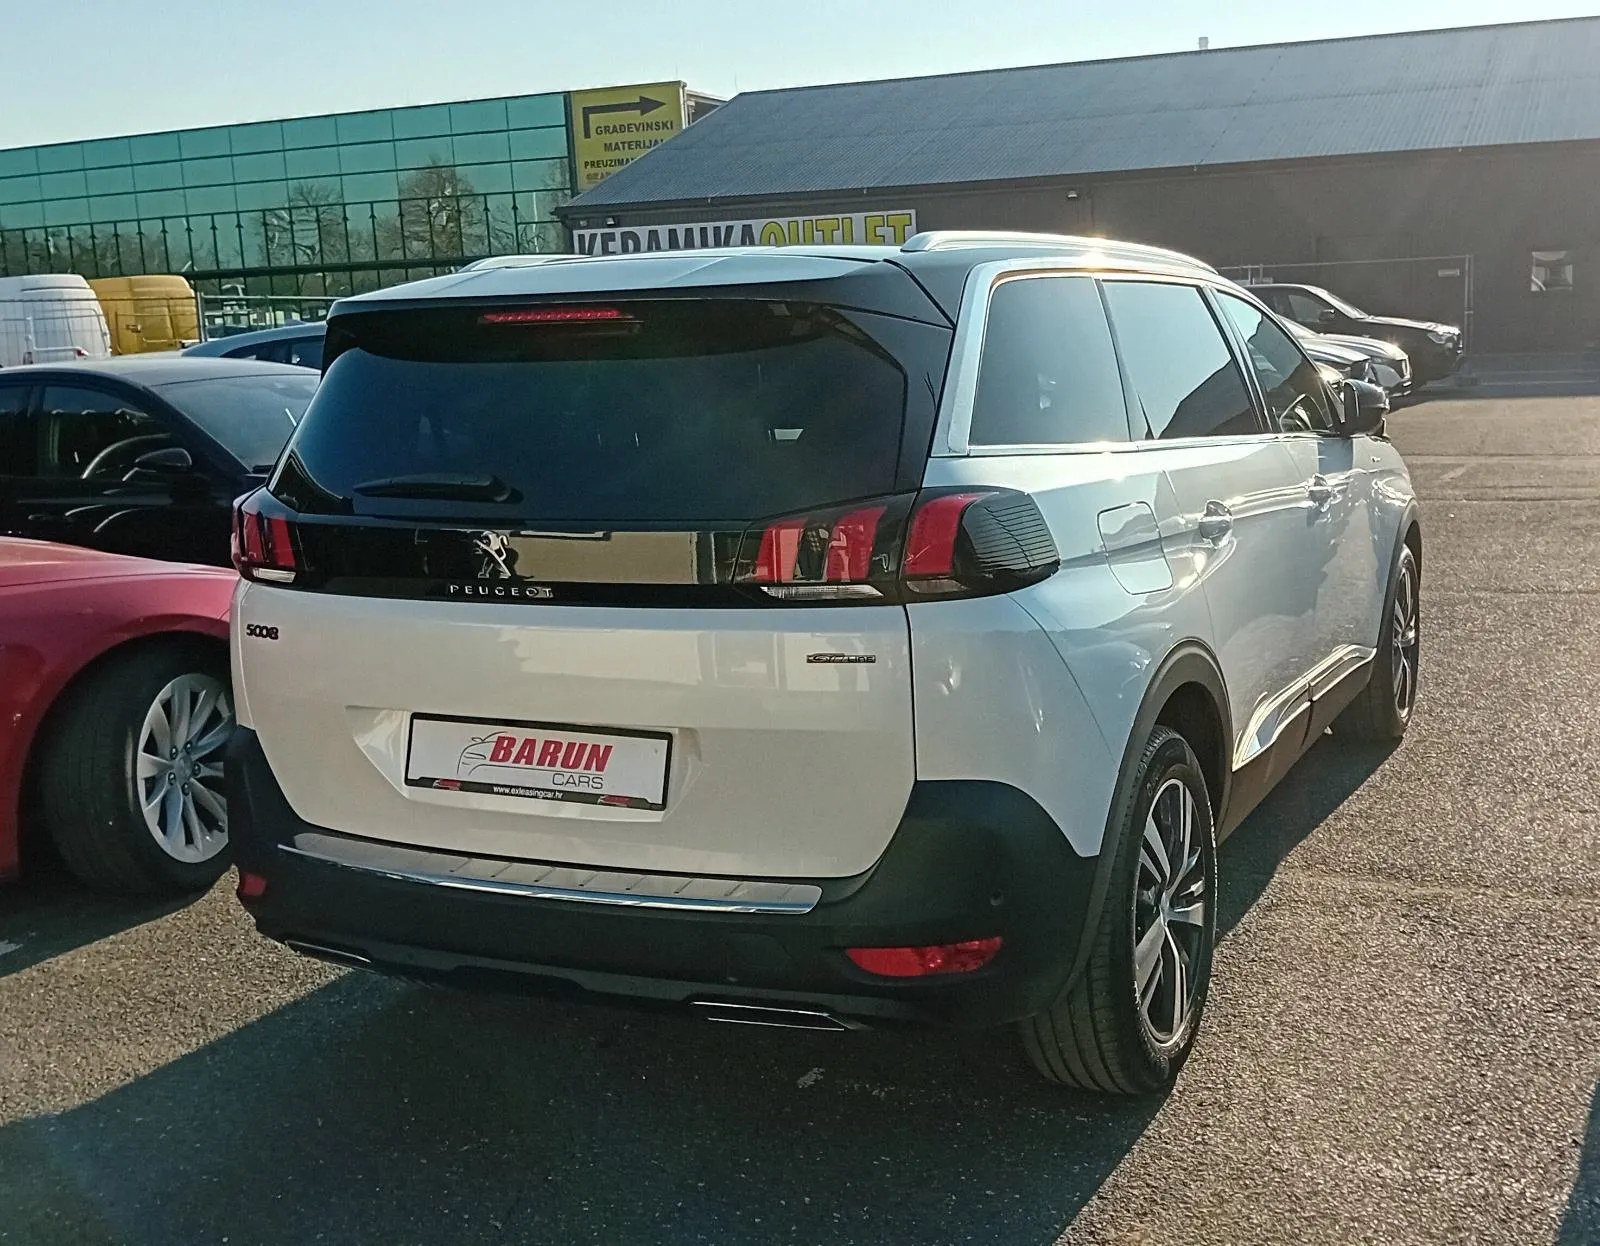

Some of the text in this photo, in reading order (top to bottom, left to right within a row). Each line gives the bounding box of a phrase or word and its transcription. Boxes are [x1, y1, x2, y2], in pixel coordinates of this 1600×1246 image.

[604, 139, 664, 152] MATERIJA
[584, 157, 634, 169] PREUZIMA
[449, 584, 553, 597] PEUGEOT
[246, 623, 279, 640] 5008
[489, 735, 613, 772] BARUN
[552, 772, 604, 790] CARS
[493, 785, 564, 800] www.exleasingcar.hr
